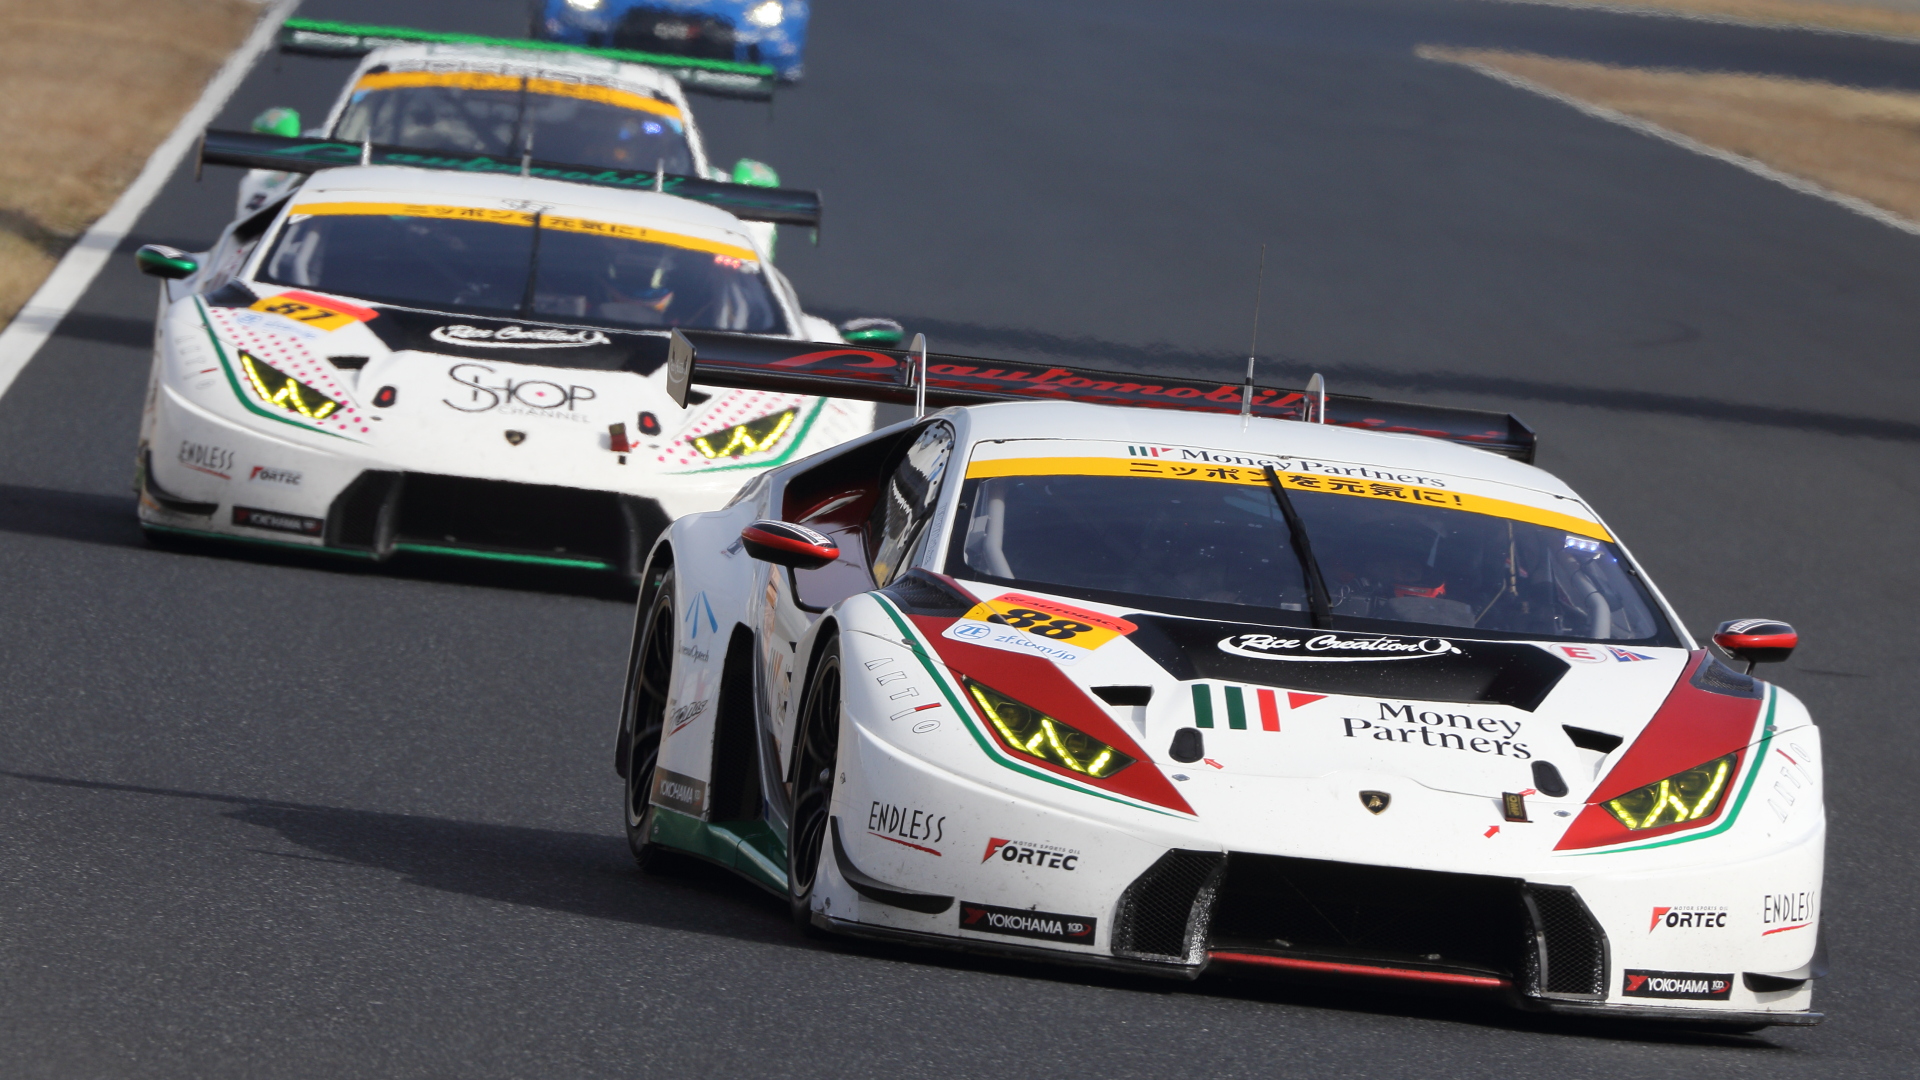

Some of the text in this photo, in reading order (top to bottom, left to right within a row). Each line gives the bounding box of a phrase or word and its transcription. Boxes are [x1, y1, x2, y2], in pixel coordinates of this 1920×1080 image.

[497, 405, 591, 424] CHANNEL
[177, 440, 235, 471] ENDLESS
[1180, 448, 1447, 488] Money Partners
[986, 608, 1094, 640] 88
[994, 635, 1077, 661] zf.com/jp
[1239, 634, 1420, 652] Rice Creation
[1377, 702, 1521, 739] Money
[1340, 717, 1532, 760] Partners
[868, 800, 946, 843] ENDLESS
[981, 837, 1080, 871] FORTEC
[1013, 840, 1037, 849] MOTOR
[1040, 844, 1066, 853] SPORTS
[1649, 907, 1727, 934] FORTEC
[1763, 891, 1815, 924] ENDLESS
[987, 912, 1063, 936] YOKOHAMA
[1647, 977, 1709, 994] YOKOHAMA
